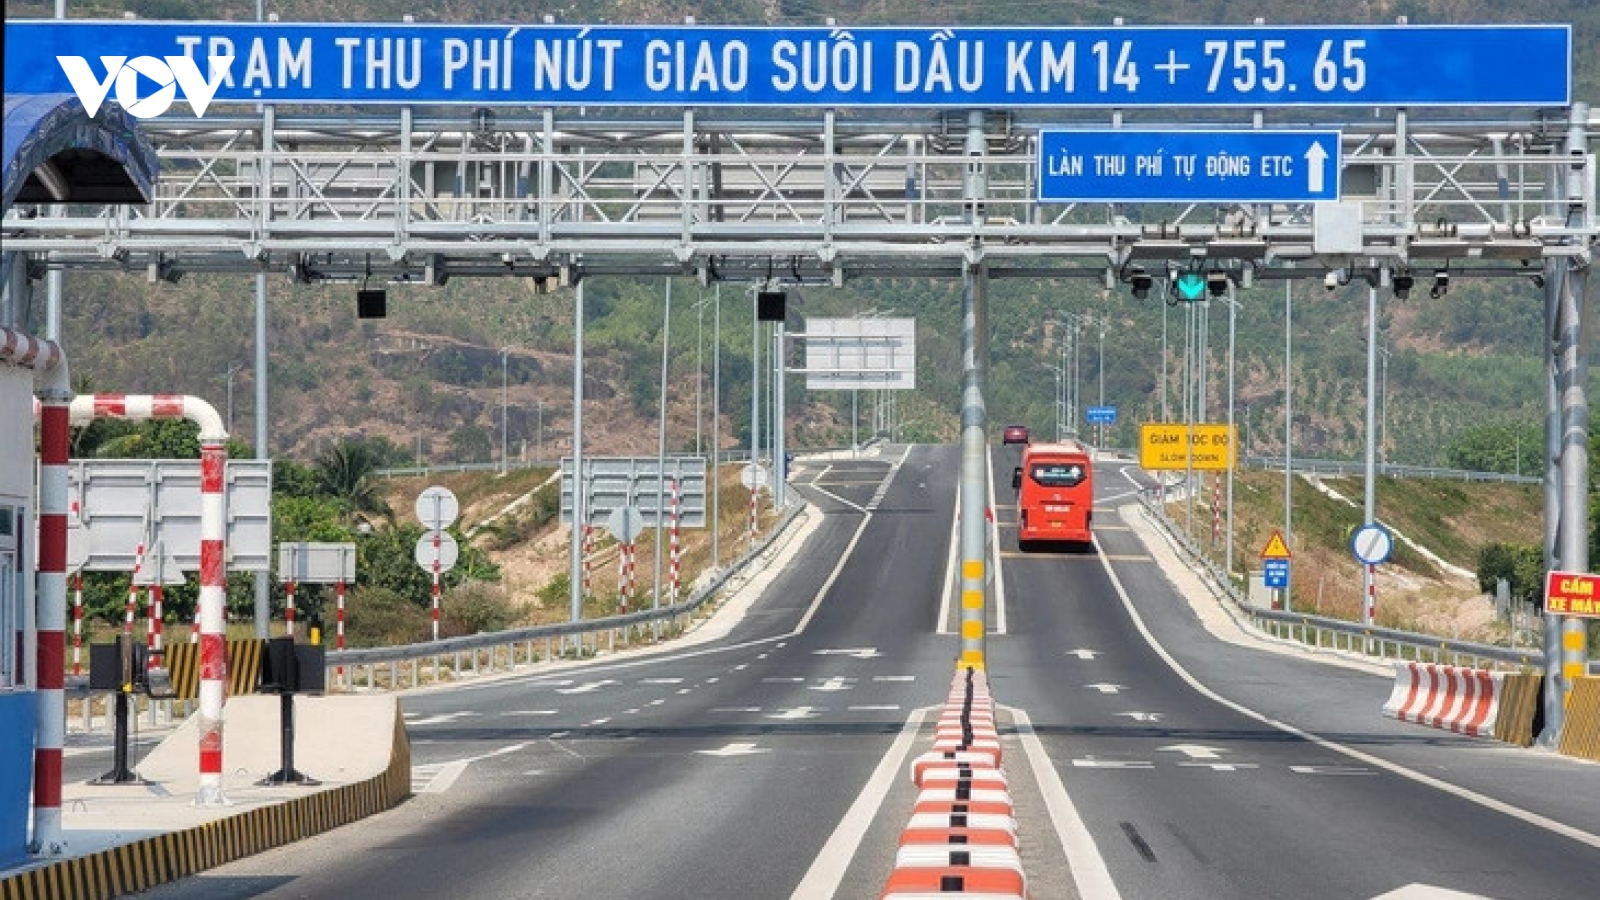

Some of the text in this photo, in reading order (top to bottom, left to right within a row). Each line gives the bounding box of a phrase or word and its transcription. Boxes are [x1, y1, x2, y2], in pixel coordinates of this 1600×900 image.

[176, 36, 312, 97] TRẠM
[335, 37, 422, 89] THU
[444, 28, 520, 90] PHÍ
[534, 28, 623, 91] NÚT
[645, 39, 748, 92] GIAO
[771, 30, 872, 92] SUỒI
[895, 30, 983, 92] DẦU
[1006, 40, 1075, 92] KM
[1092, 40, 1140, 92] 14
[1313, 40, 1366, 92] 65
[1049, 147, 1293, 181] LÀN THU PHÍ TỰ ĐỘNG ETC
